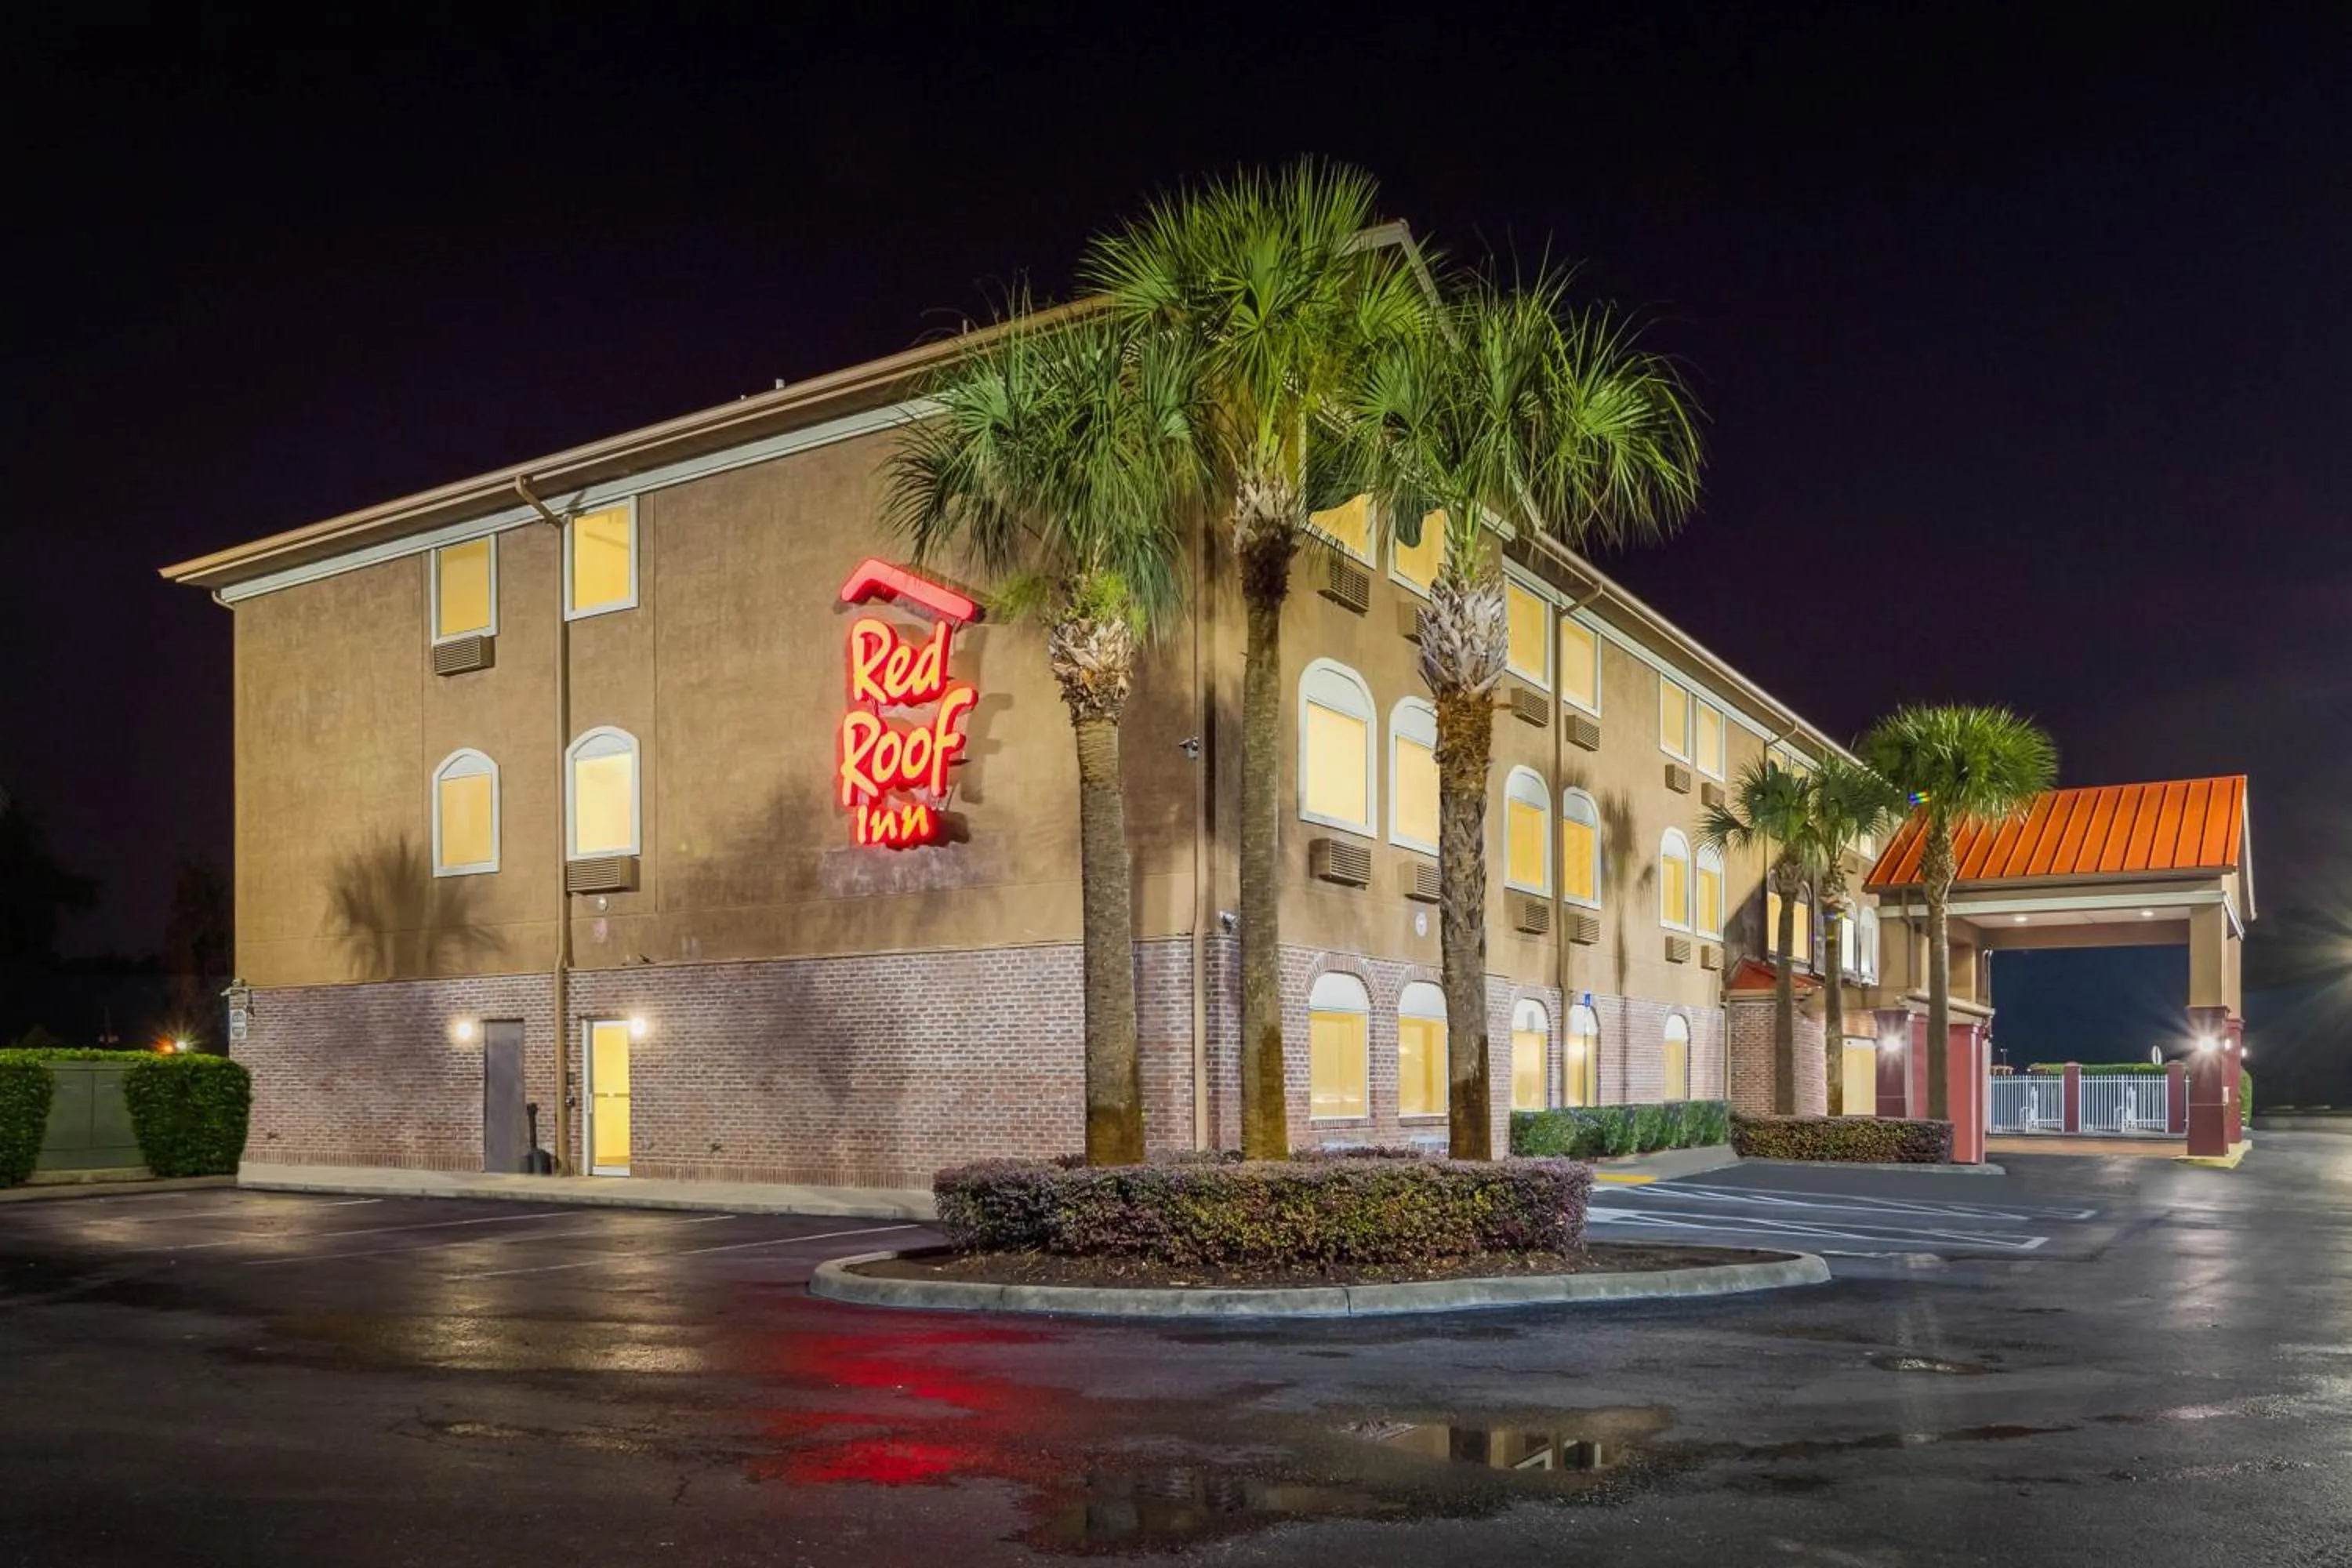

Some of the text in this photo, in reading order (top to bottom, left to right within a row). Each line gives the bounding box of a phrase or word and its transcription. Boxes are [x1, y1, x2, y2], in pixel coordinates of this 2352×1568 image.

[851, 618, 947, 704] Red
[840, 687, 974, 806] Roof
[856, 804, 930, 844] Inn
